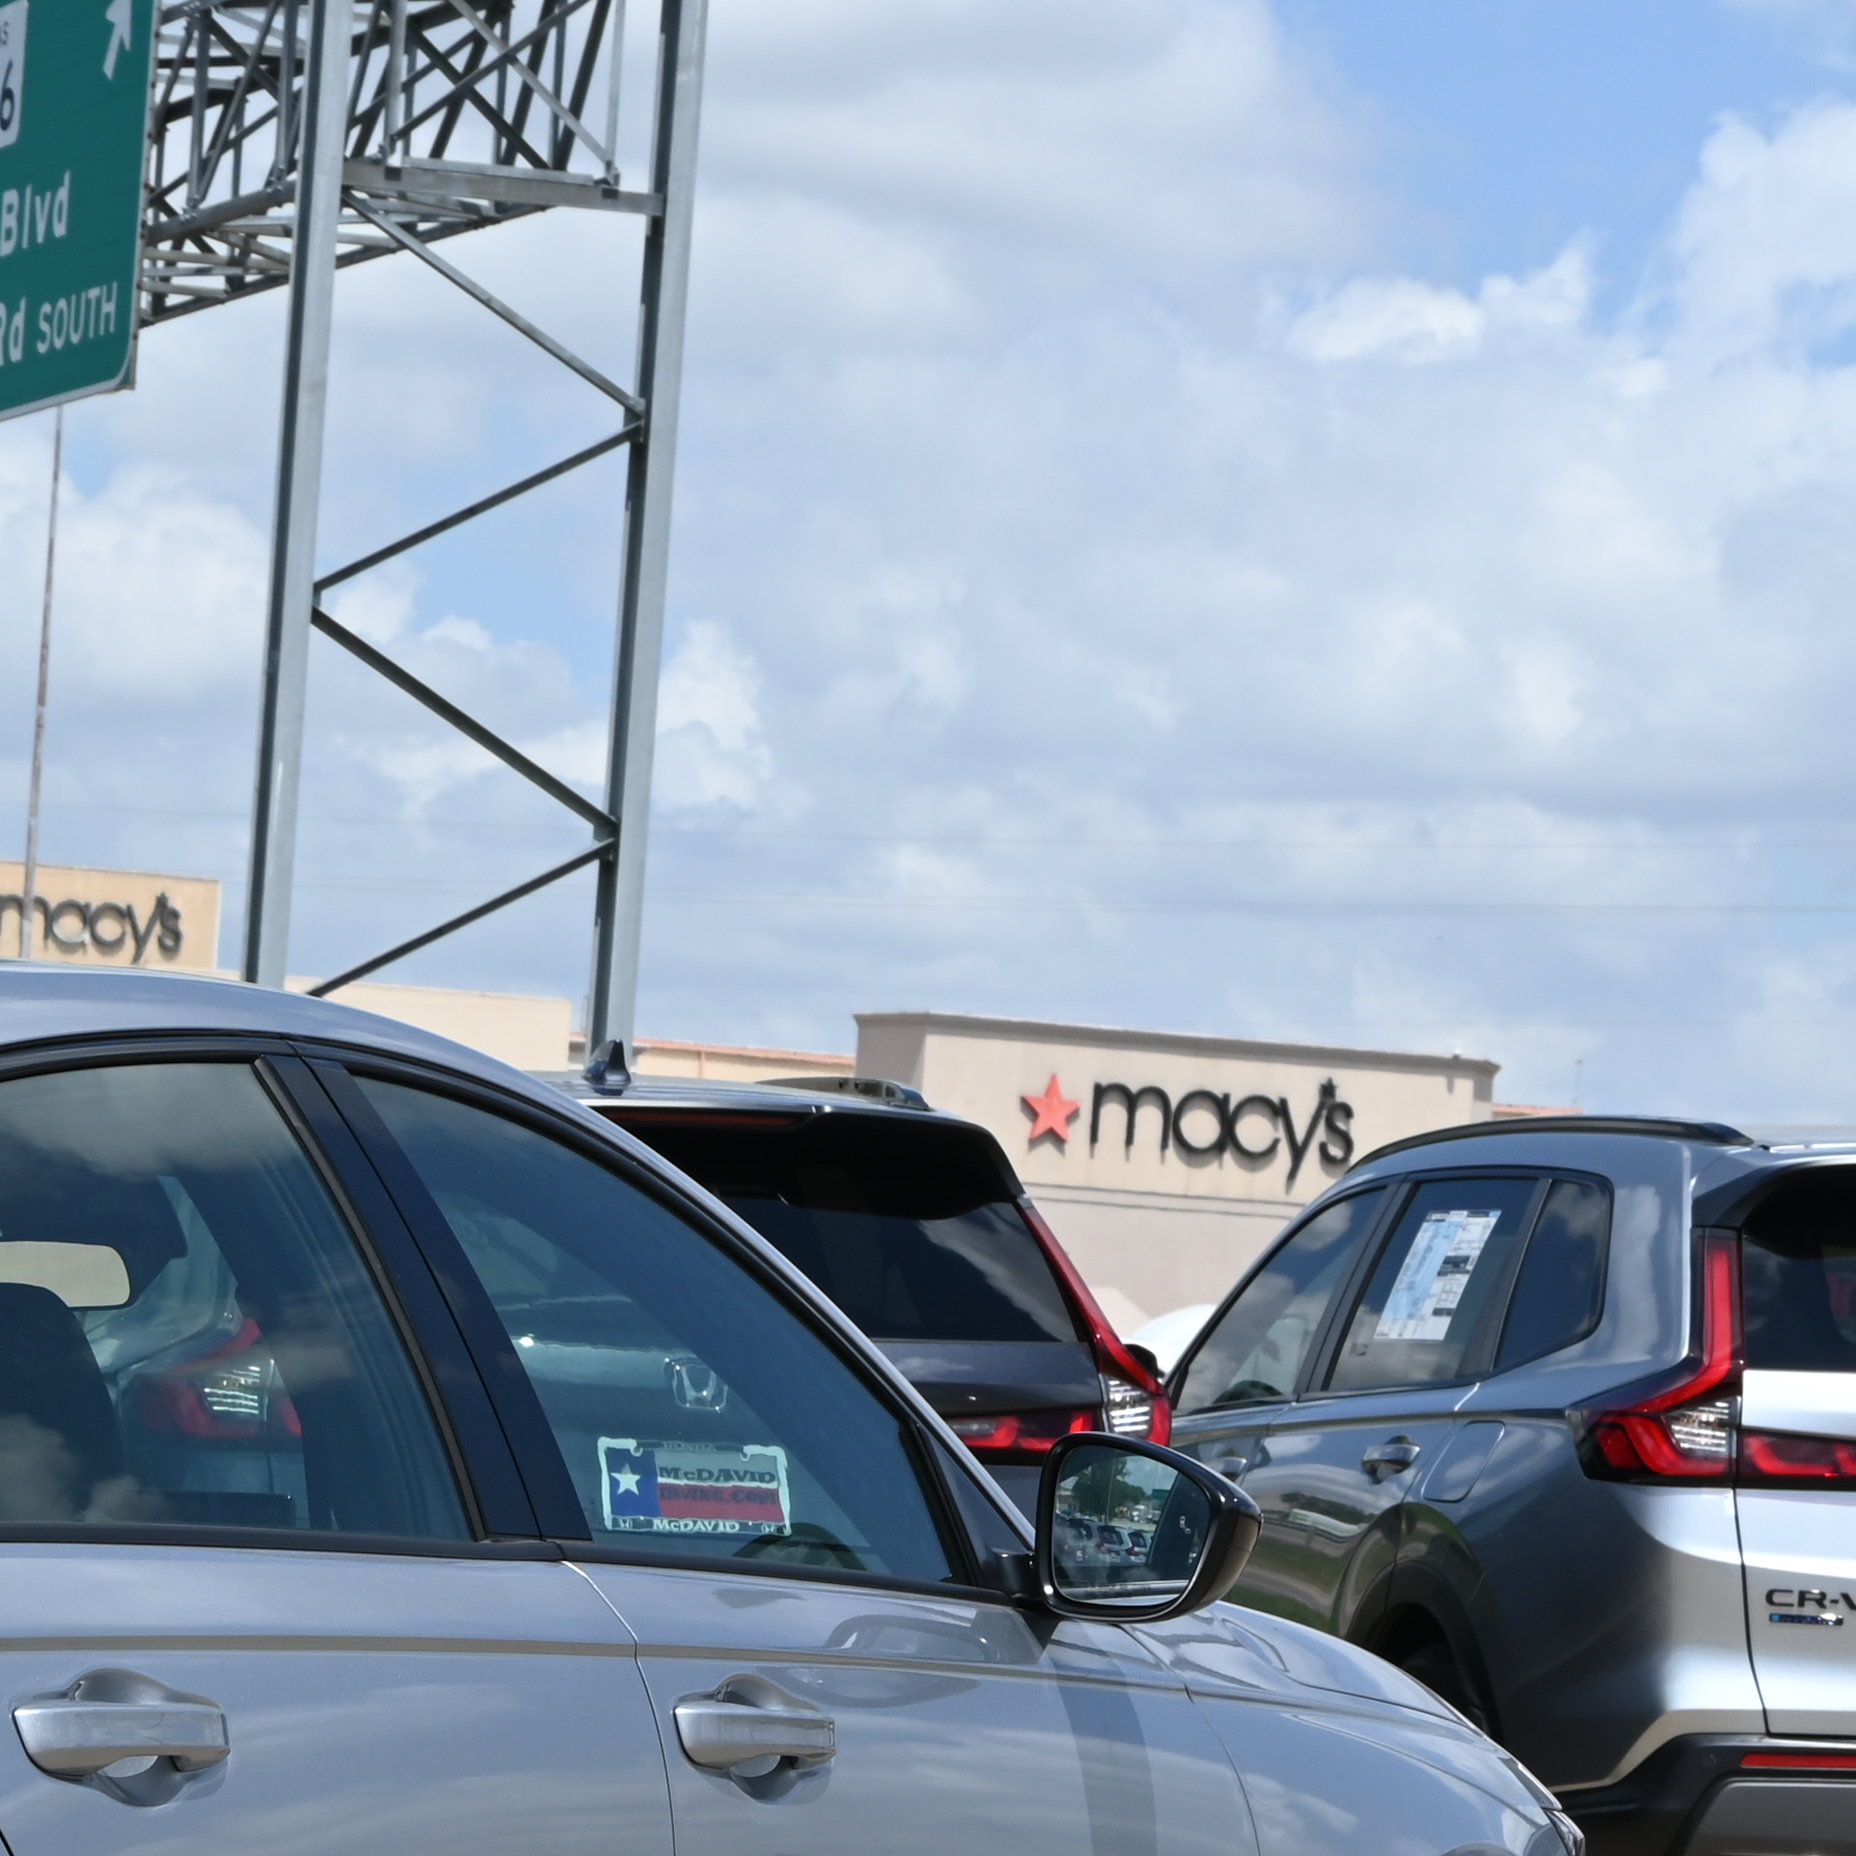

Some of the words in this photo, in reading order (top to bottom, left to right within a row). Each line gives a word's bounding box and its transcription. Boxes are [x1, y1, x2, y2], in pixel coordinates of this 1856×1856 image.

[36, 281, 118, 354] SOUTH
[1090, 1077, 1354, 1194] macy's
[660, 1467, 775, 1482] McDAVID
[652, 1518, 740, 1533] McDAVID
